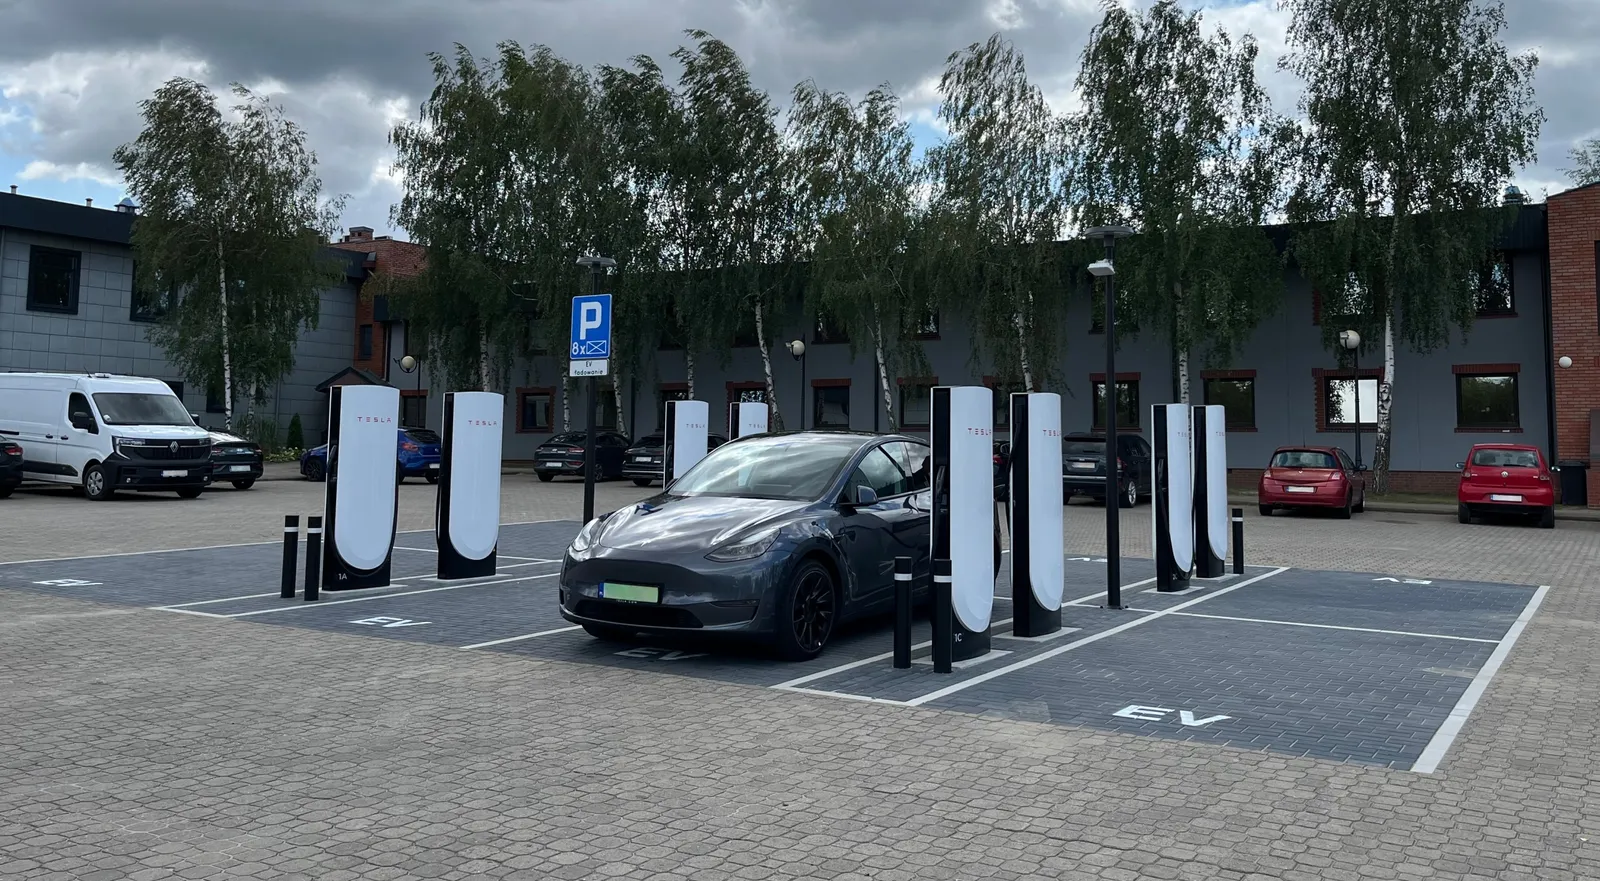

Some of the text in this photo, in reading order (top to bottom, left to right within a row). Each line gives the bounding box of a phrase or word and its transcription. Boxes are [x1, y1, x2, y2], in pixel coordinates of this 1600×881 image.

[580, 301, 602, 340] P
[572, 341, 586, 355] 8x
[585, 360, 593, 368] EV
[338, 572, 348, 580] 1A
[347, 616, 433, 628] EV
[954, 632, 963, 643] 1C
[1112, 704, 1233, 727] EV
